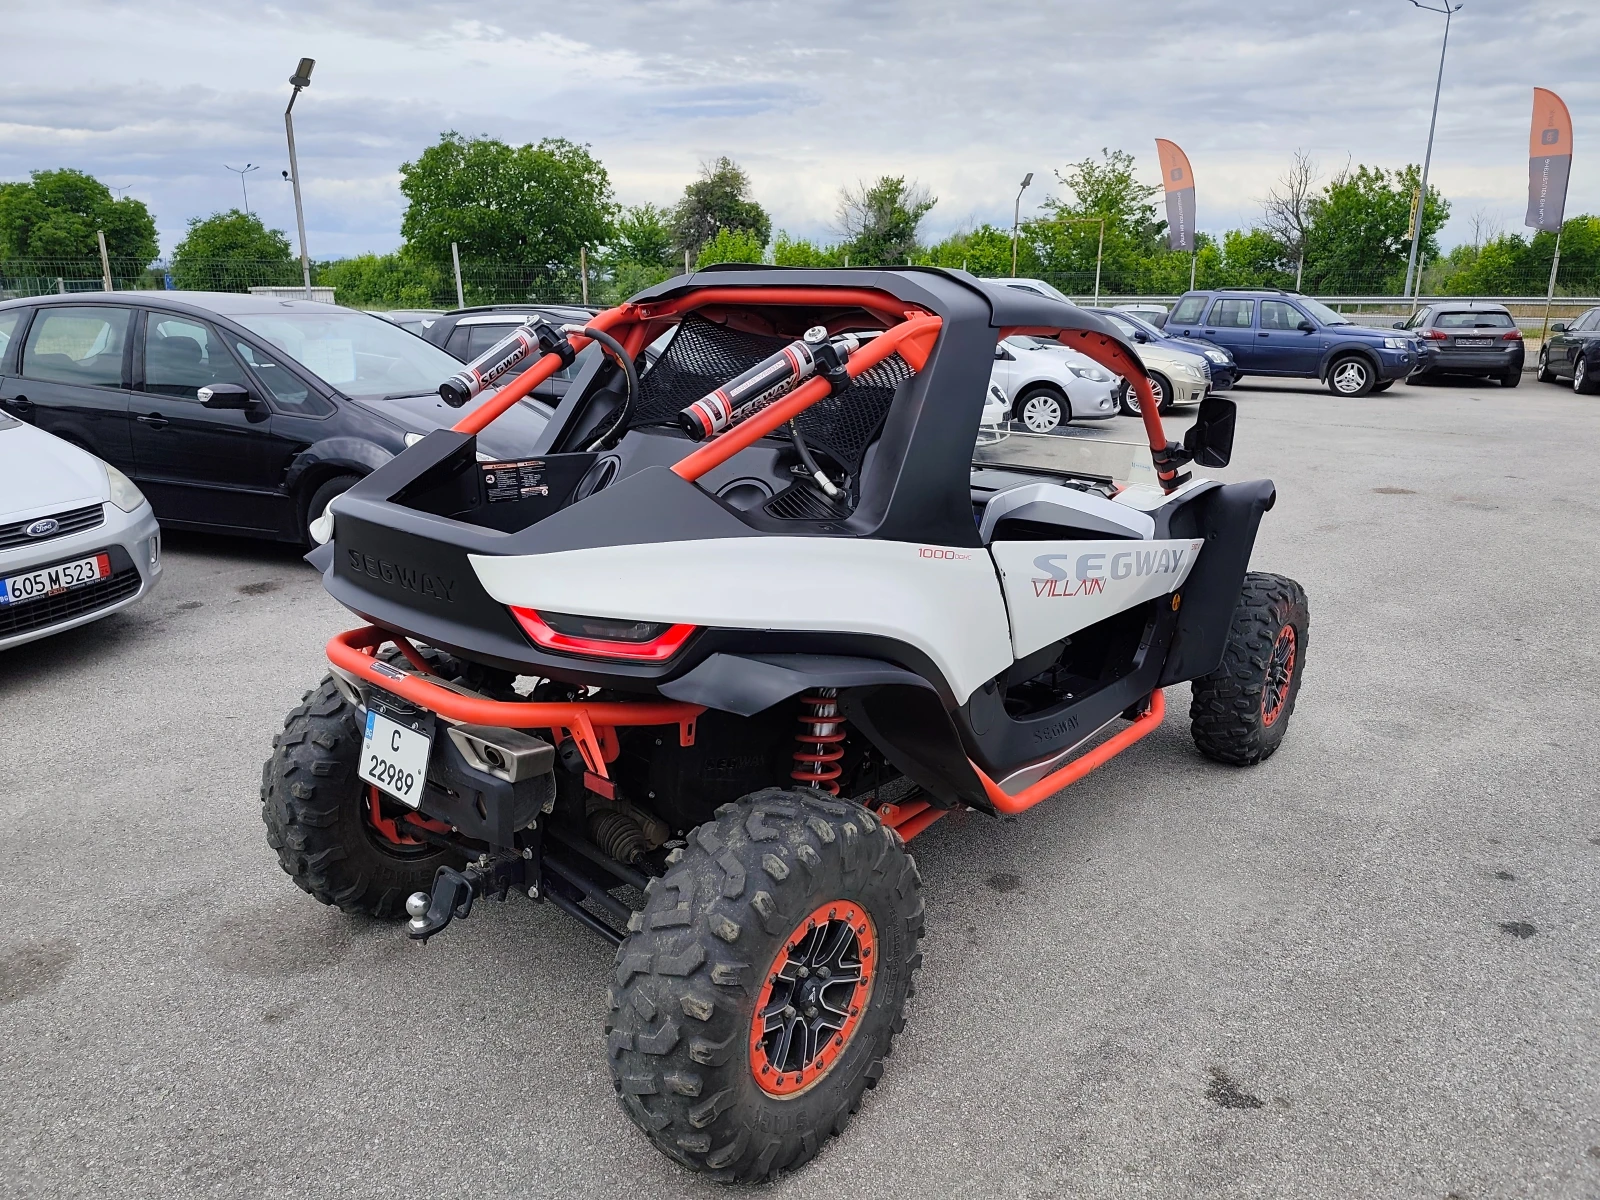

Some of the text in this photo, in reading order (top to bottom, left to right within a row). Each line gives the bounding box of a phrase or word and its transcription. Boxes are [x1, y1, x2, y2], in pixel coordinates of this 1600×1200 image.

[480, 344, 527, 385] SEGWAY
[35, 521, 53, 533] Ford
[918, 548, 955, 560] 1000
[1031, 548, 1184, 583] SEGWAY
[347, 548, 455, 603] SEGWAY
[1031, 578, 1107, 598] VILLAIN
[391, 729, 402, 752] C
[1032, 713, 1080, 745] SEGWAY
[368, 754, 414, 796] 22989
